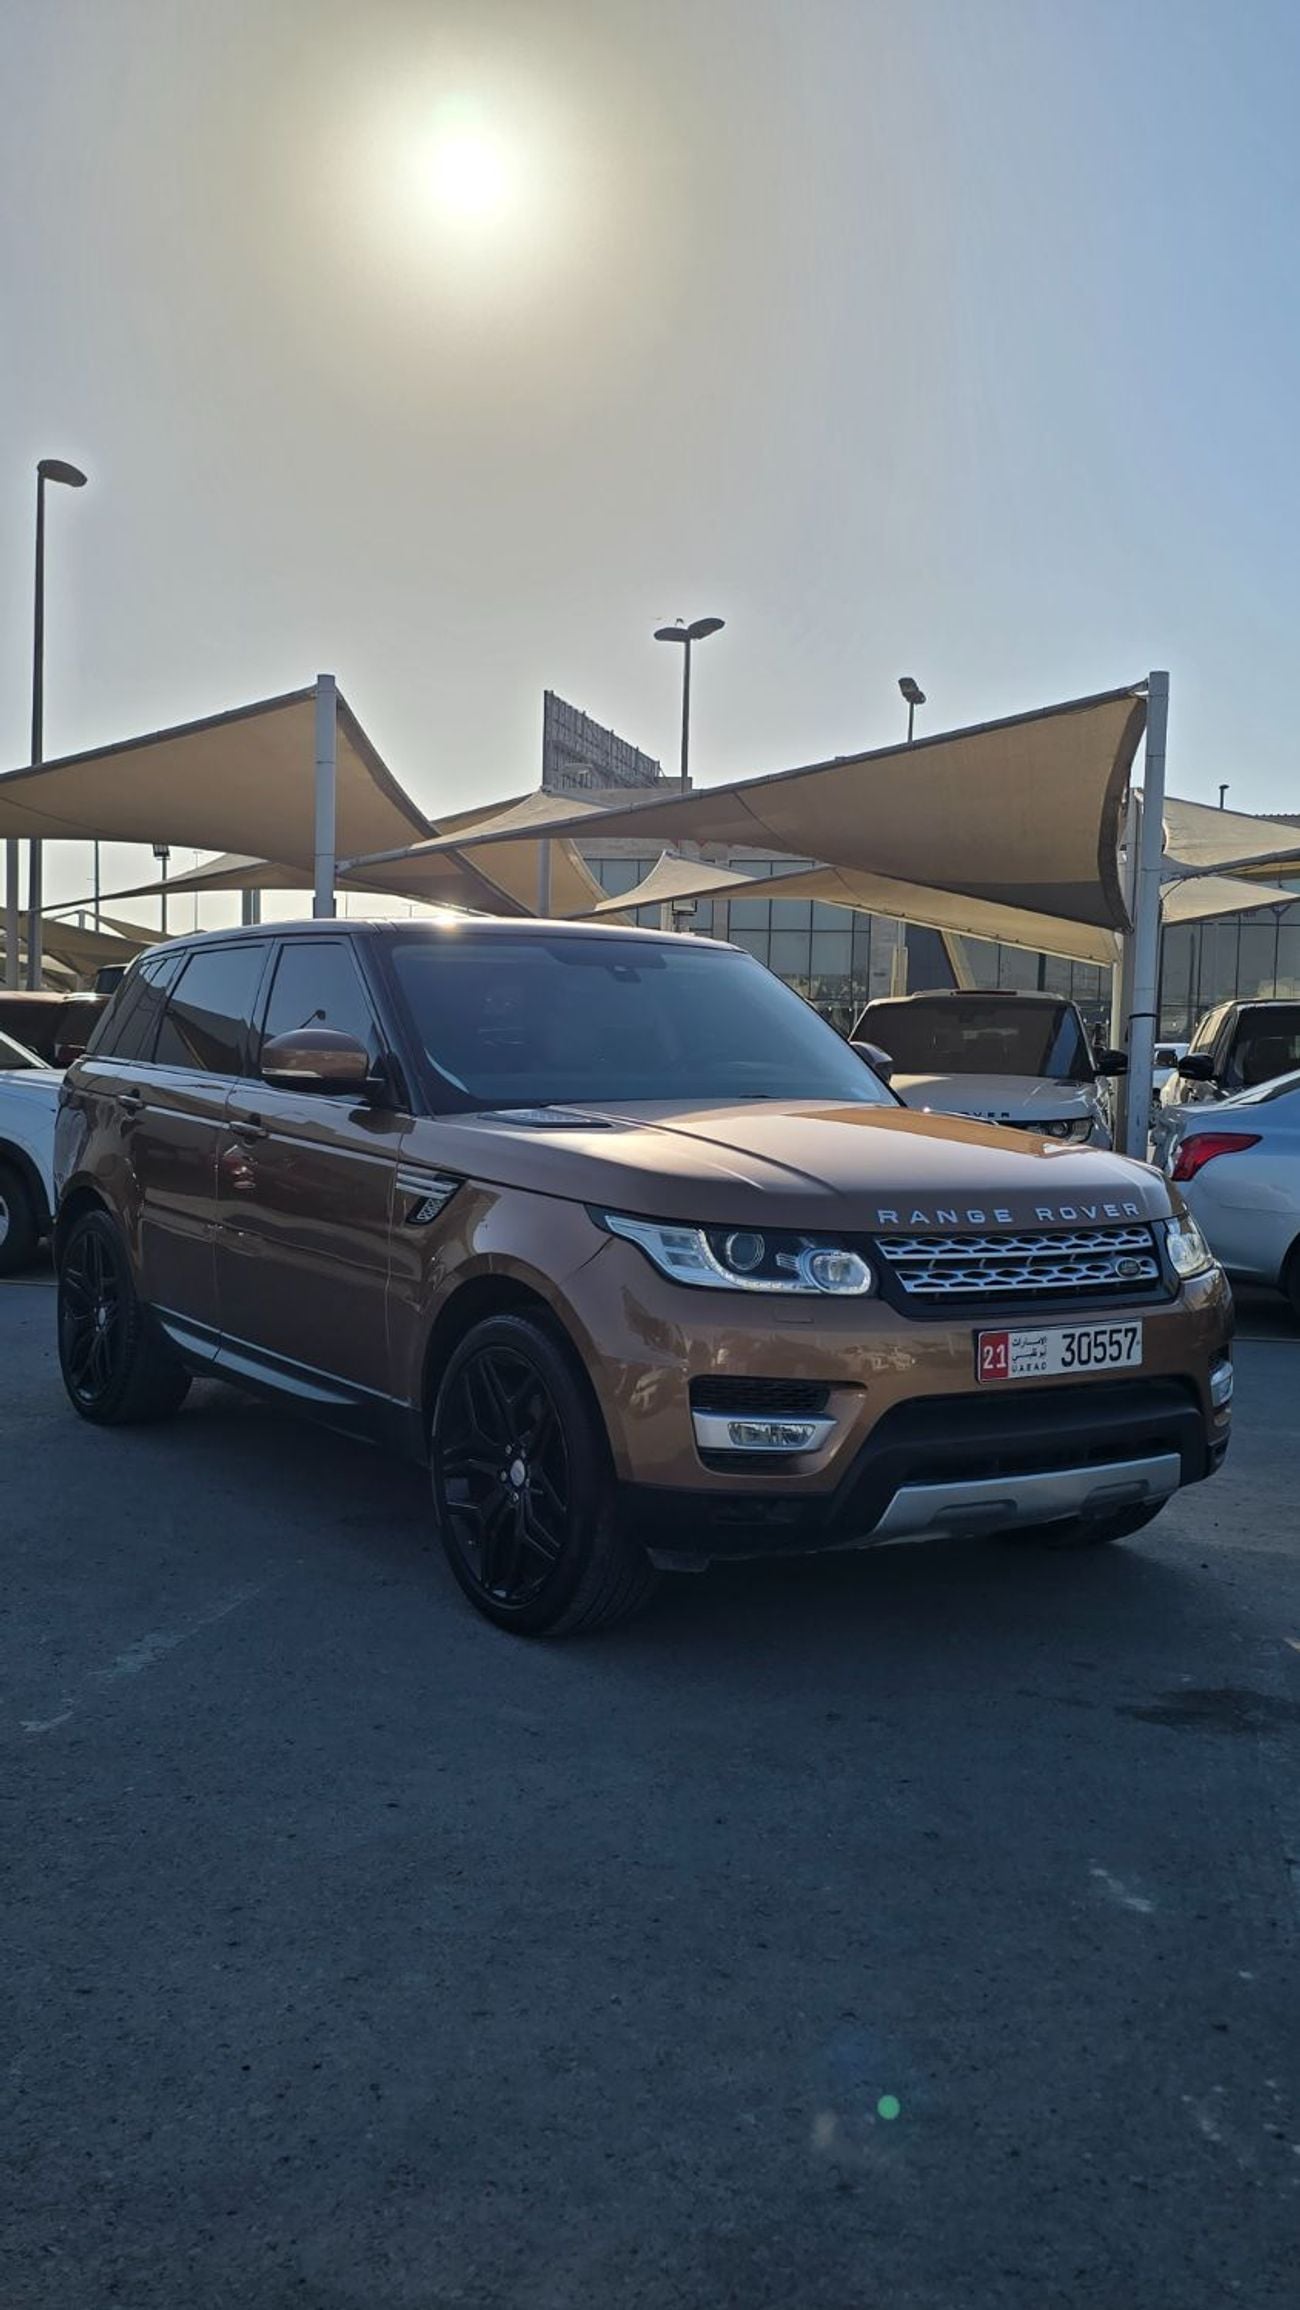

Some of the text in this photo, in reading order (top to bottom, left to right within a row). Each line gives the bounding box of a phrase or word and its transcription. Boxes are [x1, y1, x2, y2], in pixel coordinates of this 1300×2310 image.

[877, 1203, 1140, 1225] RANGE ROVER
[983, 1344, 1007, 1370] 21
[1061, 1327, 1138, 1367] 30557
